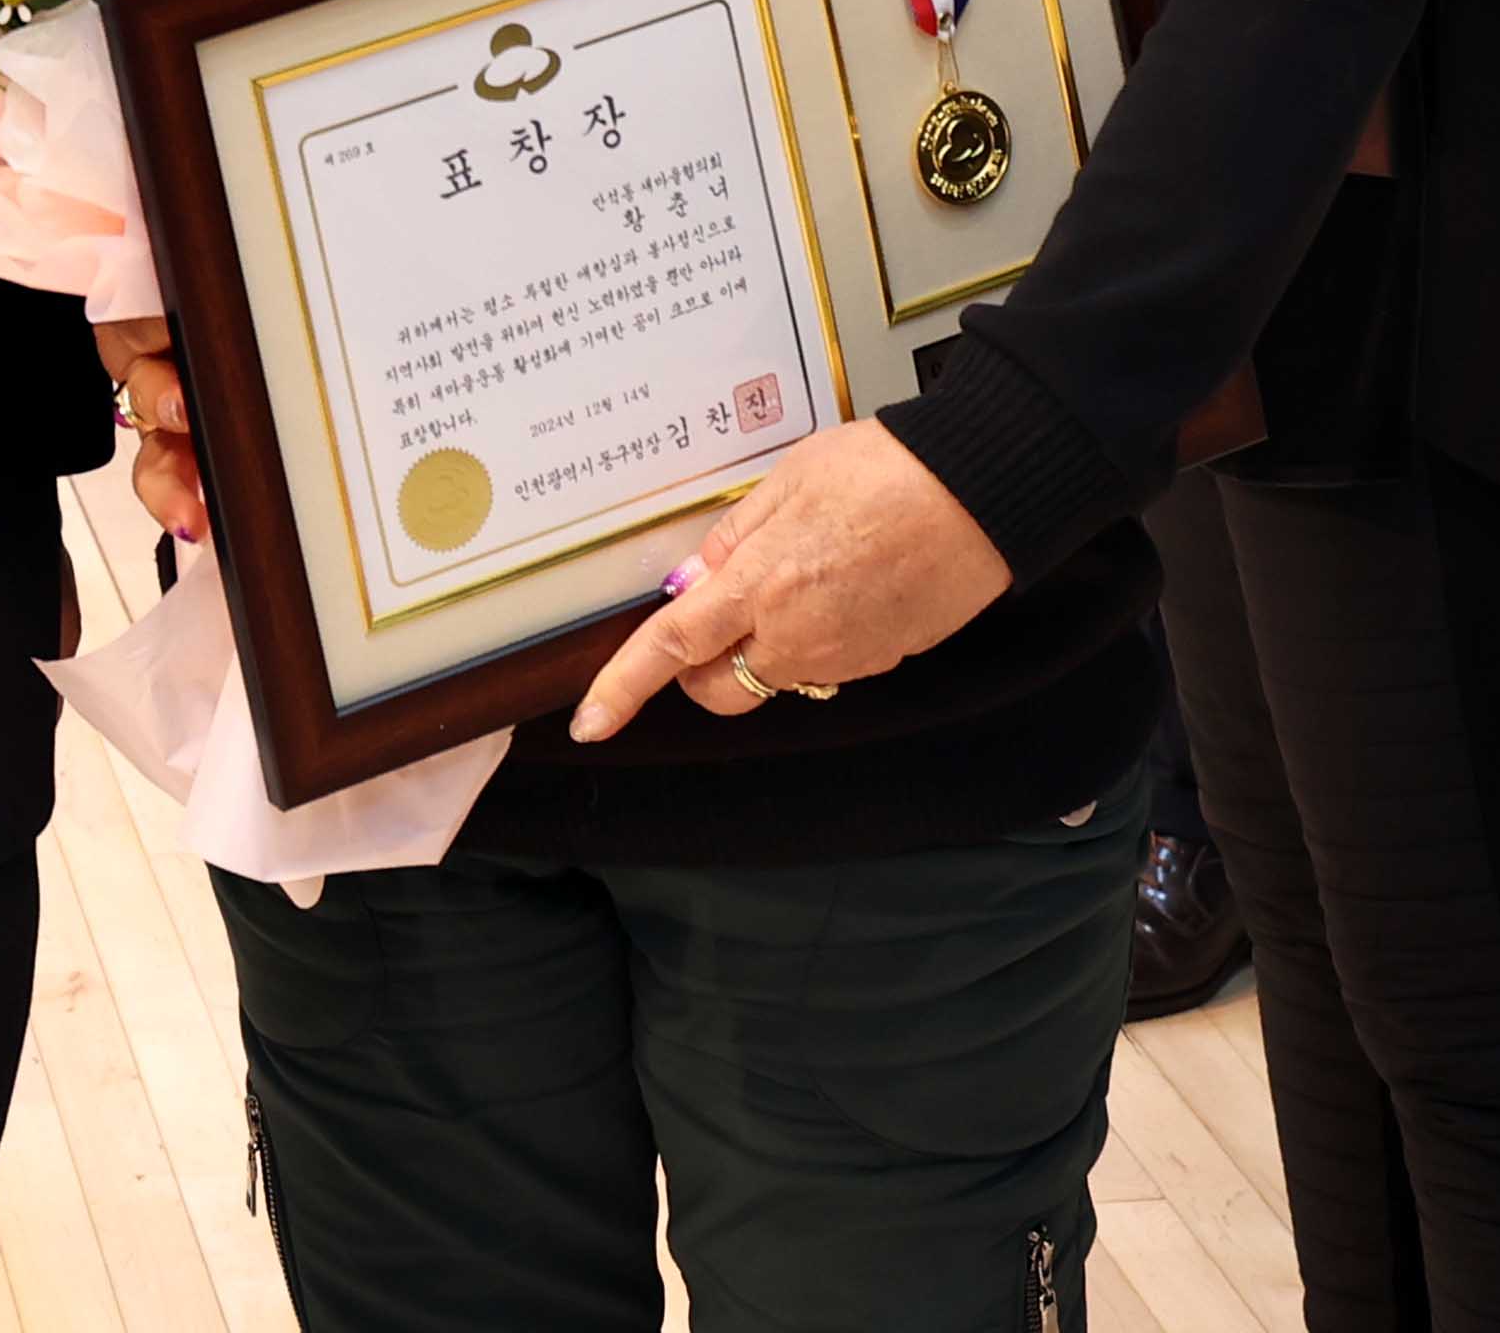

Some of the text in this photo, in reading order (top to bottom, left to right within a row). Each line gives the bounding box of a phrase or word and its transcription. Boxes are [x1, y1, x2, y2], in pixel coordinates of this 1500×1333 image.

[440, 95, 626, 199] 표 창 장
[623, 206, 645, 233] 황
[709, 175, 729, 201] 녀
[385, 350, 443, 384] 지역사회
[451, 332, 494, 363] 발전을
[501, 315, 545, 344] 위하여
[552, 301, 579, 327] 헌신
[700, 245, 742, 272] 아니라
[392, 276, 748, 416] 특히 새마을운동 활성화에 기여한 공이 크므로 이에
[483, 293, 515, 317] 평소
[514, 456, 595, 502] 인천광역시
[598, 433, 660, 473] 동구청장
[668, 416, 690, 450] 김
[705, 402, 732, 435] 찬
[745, 387, 767, 420] 진
